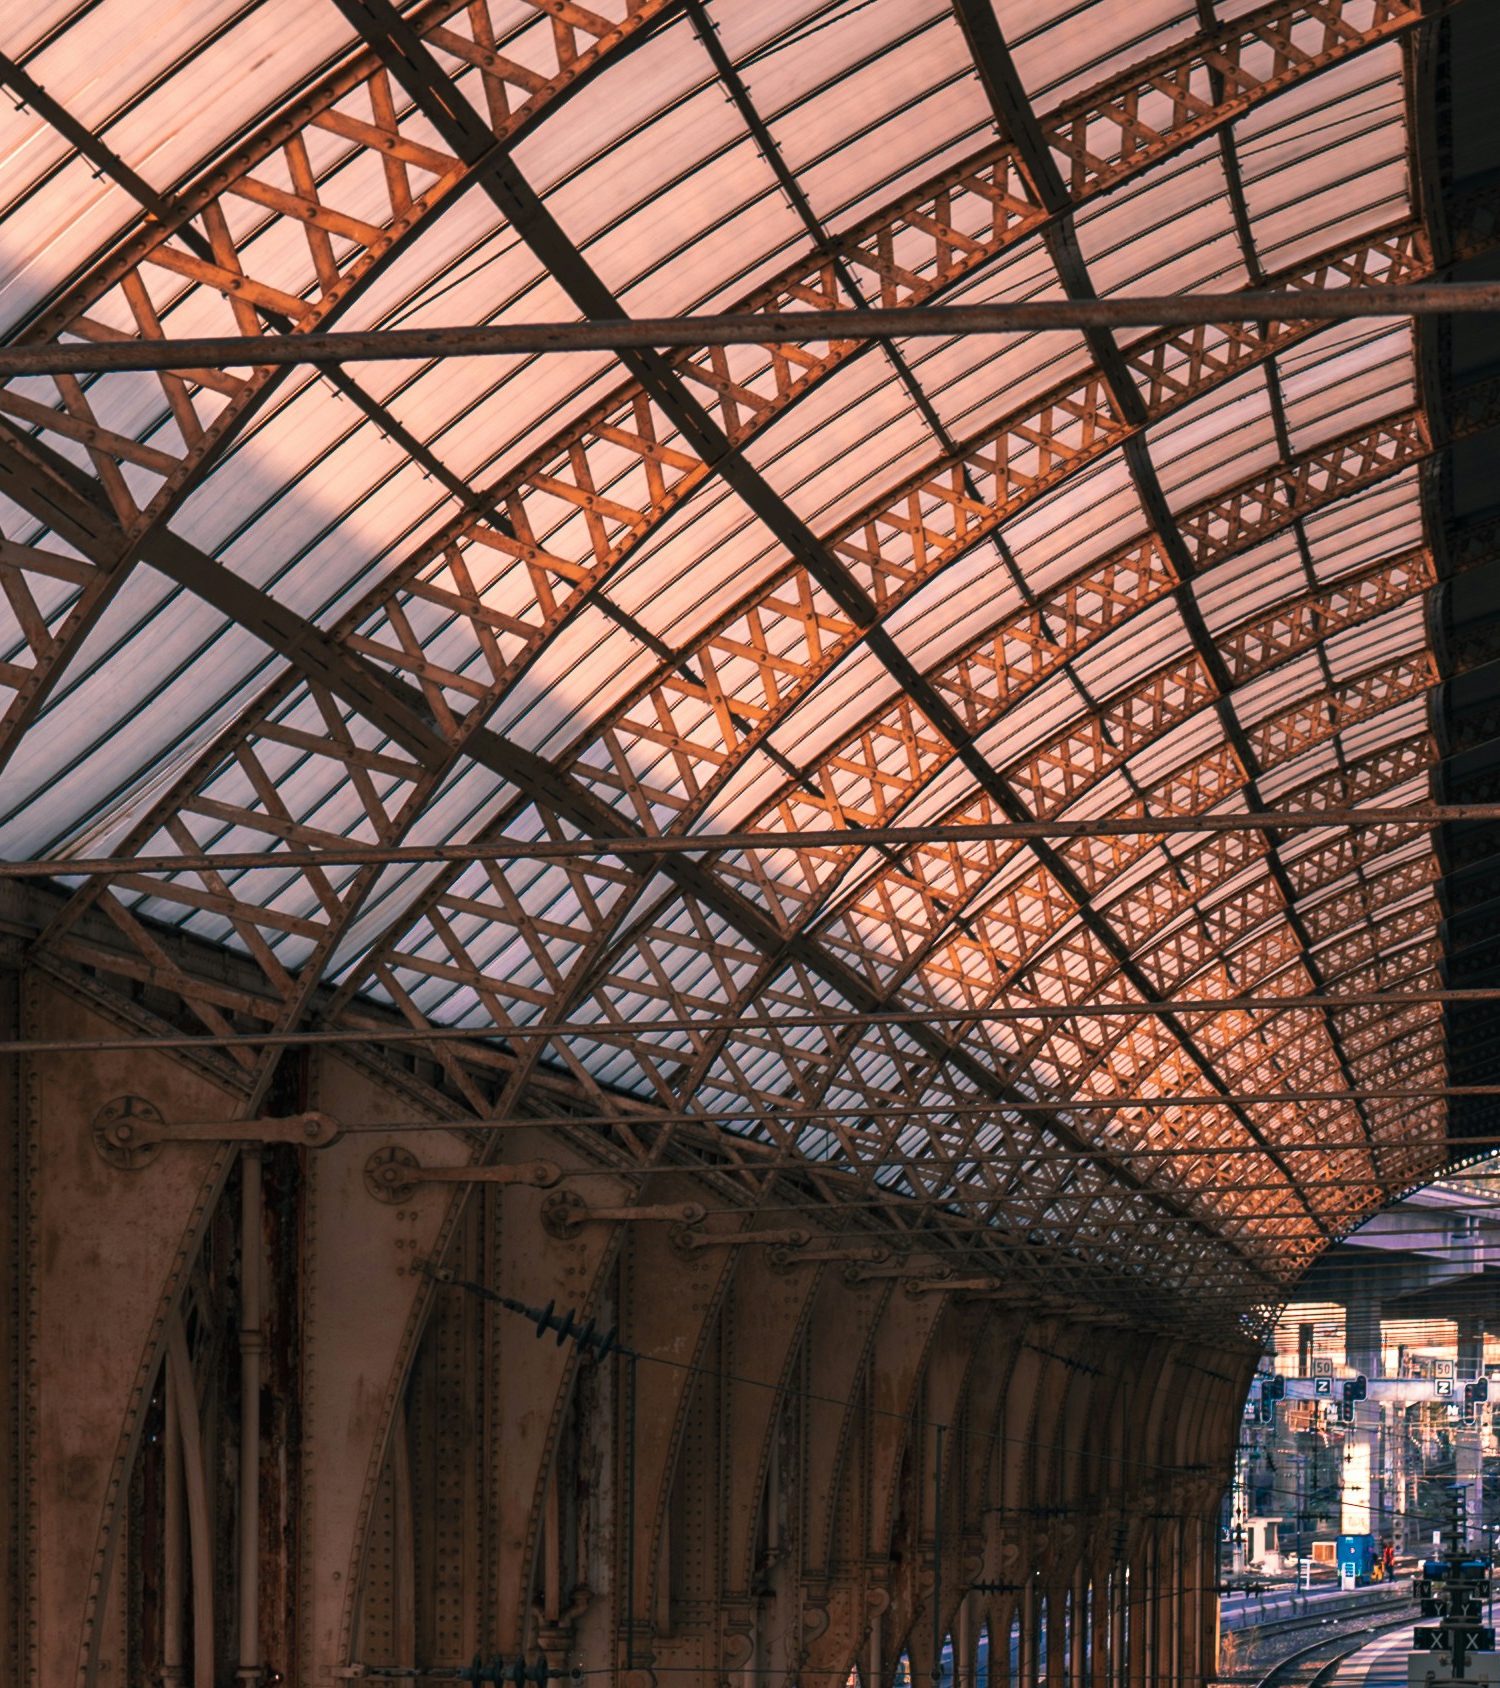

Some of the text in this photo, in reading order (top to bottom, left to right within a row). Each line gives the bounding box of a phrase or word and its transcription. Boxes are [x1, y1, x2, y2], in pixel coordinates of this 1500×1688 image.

[1316, 1361, 1330, 1373] 50
[1437, 1363, 1450, 1375] 50
[1318, 1381, 1328, 1392] Z
[1438, 1382, 1449, 1394] Z
[1434, 1603, 1443, 1615] Y
[1461, 1603, 1470, 1616] Y
[1430, 1632, 1443, 1649] X
[1466, 1633, 1479, 1649] X
